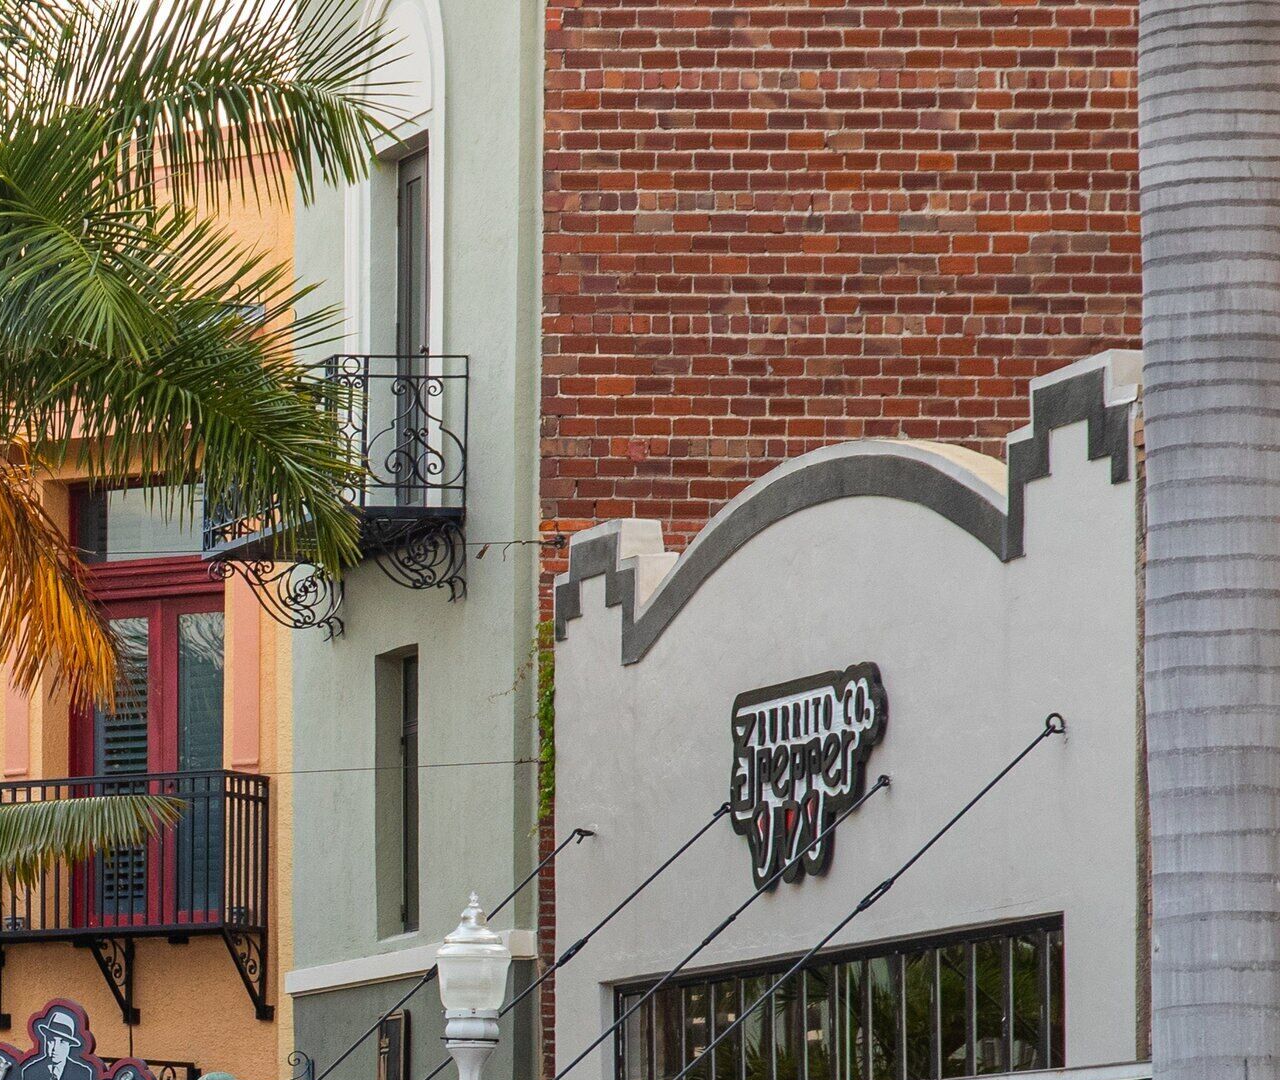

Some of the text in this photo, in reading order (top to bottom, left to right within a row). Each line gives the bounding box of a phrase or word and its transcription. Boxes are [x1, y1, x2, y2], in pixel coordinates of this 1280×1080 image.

[758, 686, 873, 746] BURRITO CO.
[735, 712, 756, 812] 3
